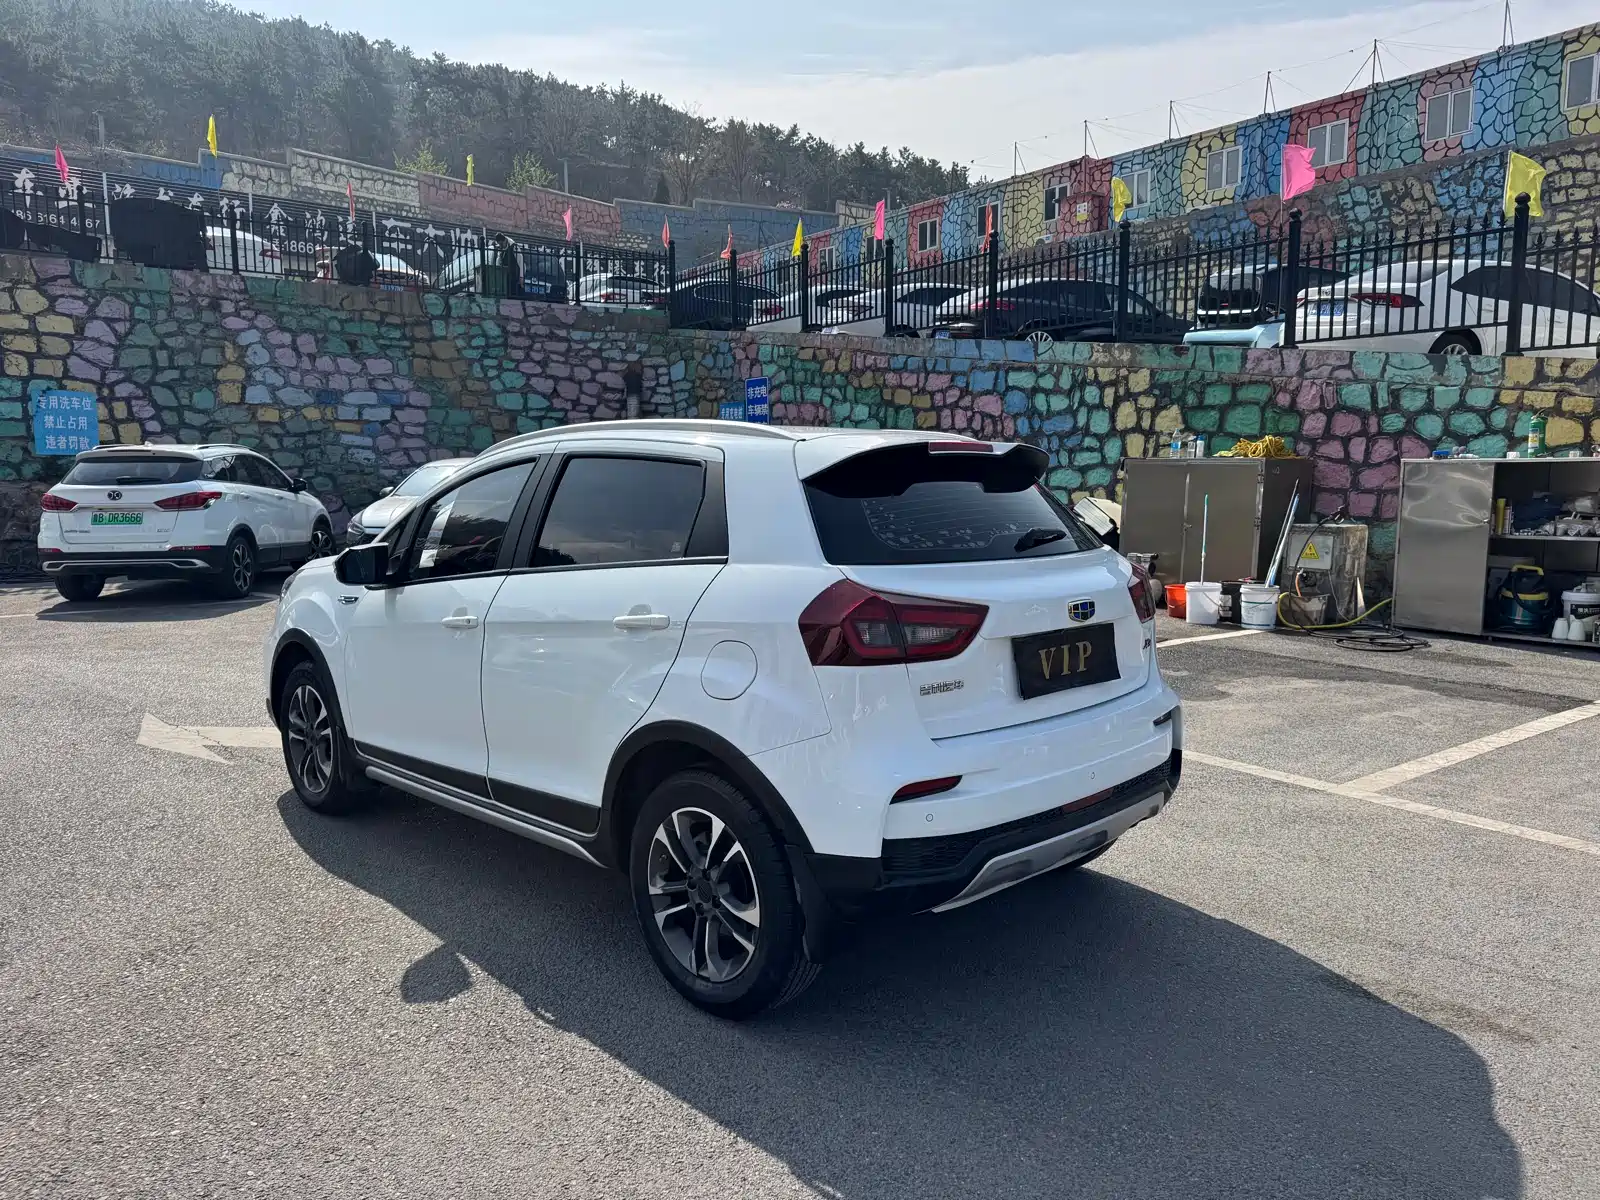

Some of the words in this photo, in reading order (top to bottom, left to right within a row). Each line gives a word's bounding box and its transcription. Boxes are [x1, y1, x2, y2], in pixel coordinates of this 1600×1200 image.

[70, 216, 101, 229] 467
[747, 385, 767, 399] 非充电
[36, 395, 93, 411] 专用洗车位
[747, 403, 768, 416] 车辆禁
[43, 414, 88, 430] 禁止占用
[45, 435, 90, 450] 违者罚款
[108, 512, 142, 523] DR3666
[1038, 641, 1092, 680] VIP
